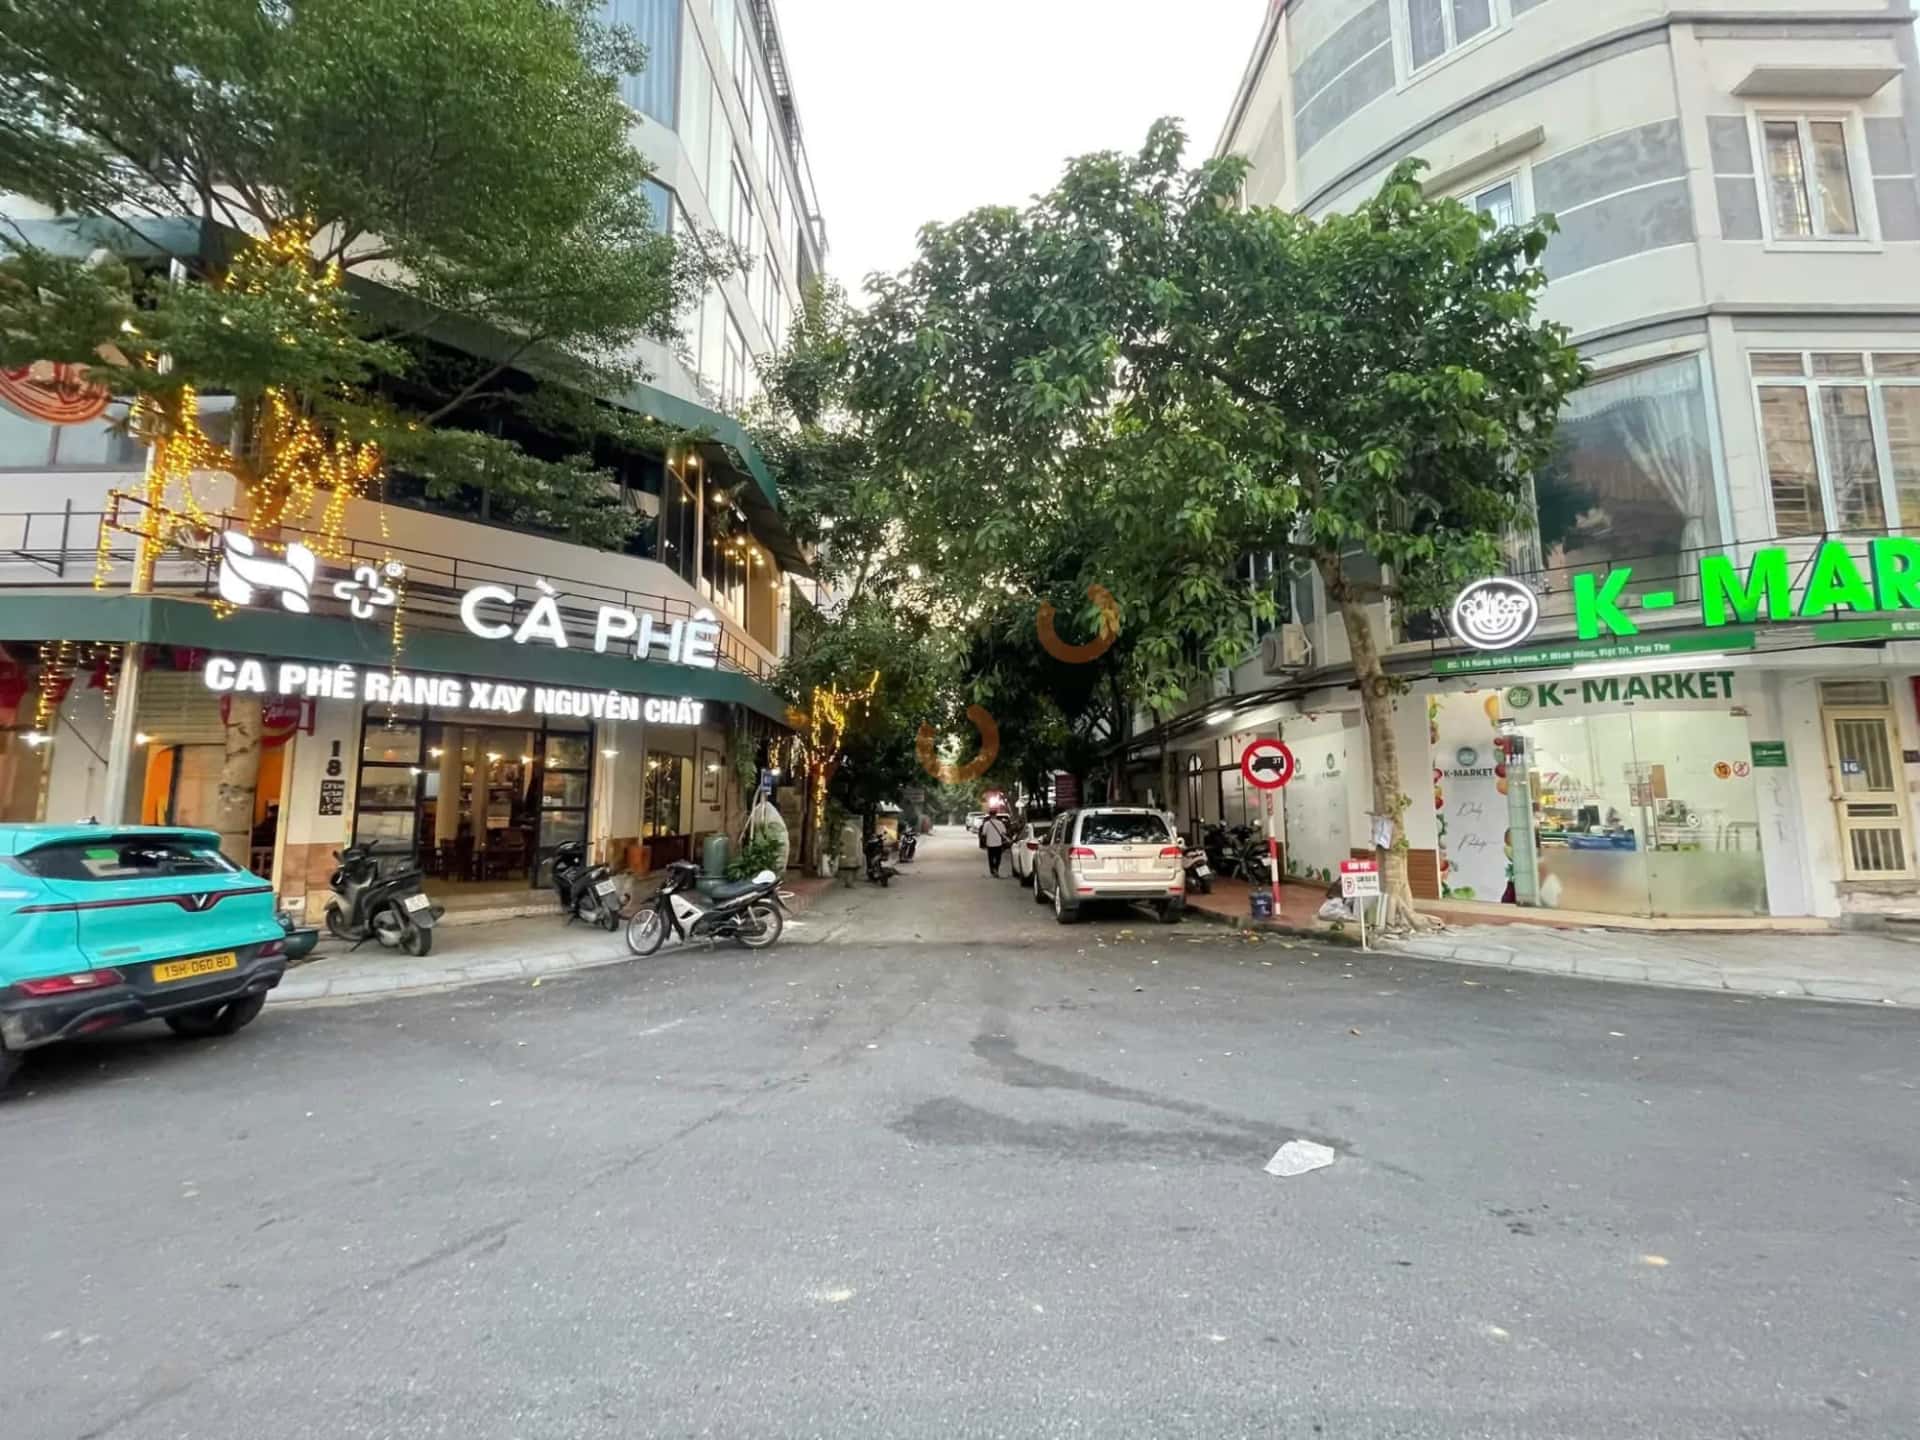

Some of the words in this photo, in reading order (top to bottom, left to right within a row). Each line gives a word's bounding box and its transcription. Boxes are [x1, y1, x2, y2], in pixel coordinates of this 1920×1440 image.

[460, 579, 568, 648] CÀ
[595, 606, 721, 668] PHÊ
[278, 662, 355, 699] PHÊ
[364, 671, 462, 707] RANG
[468, 681, 527, 713] XAY
[534, 688, 639, 721] NGUYÊN
[644, 696, 704, 725] CHẤT
[1537, 671, 1734, 707] K-MARKET
[1444, 768, 1493, 777] K-MARKET
[1843, 762, 1858, 773] 16
